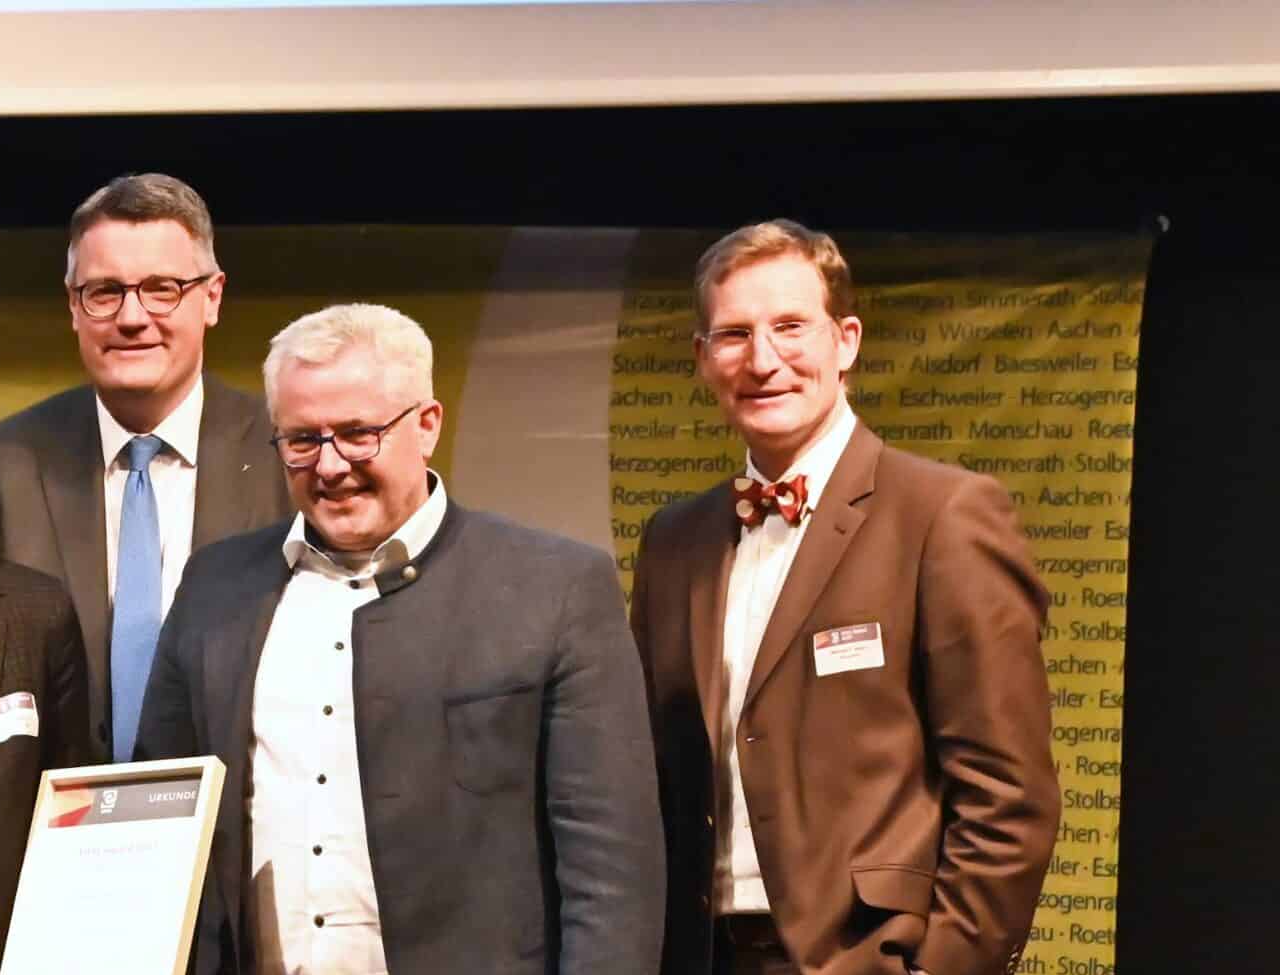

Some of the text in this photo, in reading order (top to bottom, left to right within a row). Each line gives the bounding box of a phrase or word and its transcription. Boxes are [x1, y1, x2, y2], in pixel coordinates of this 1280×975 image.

[1048, 320, 1120, 338] Aachen
[612, 352, 696, 378] Stolberg
[910, 353, 980, 375] Alsdorf
[994, 353, 1098, 374] Baesweiler
[899, 387, 1003, 408] Eschweiler
[969, 419, 1072, 440] Monschau
[958, 453, 1064, 473] Simmerath
[1039, 484, 1112, 507] Aachen
[148, 789, 197, 803] URKUNDE
[1069, 923, 1116, 945] Roet
